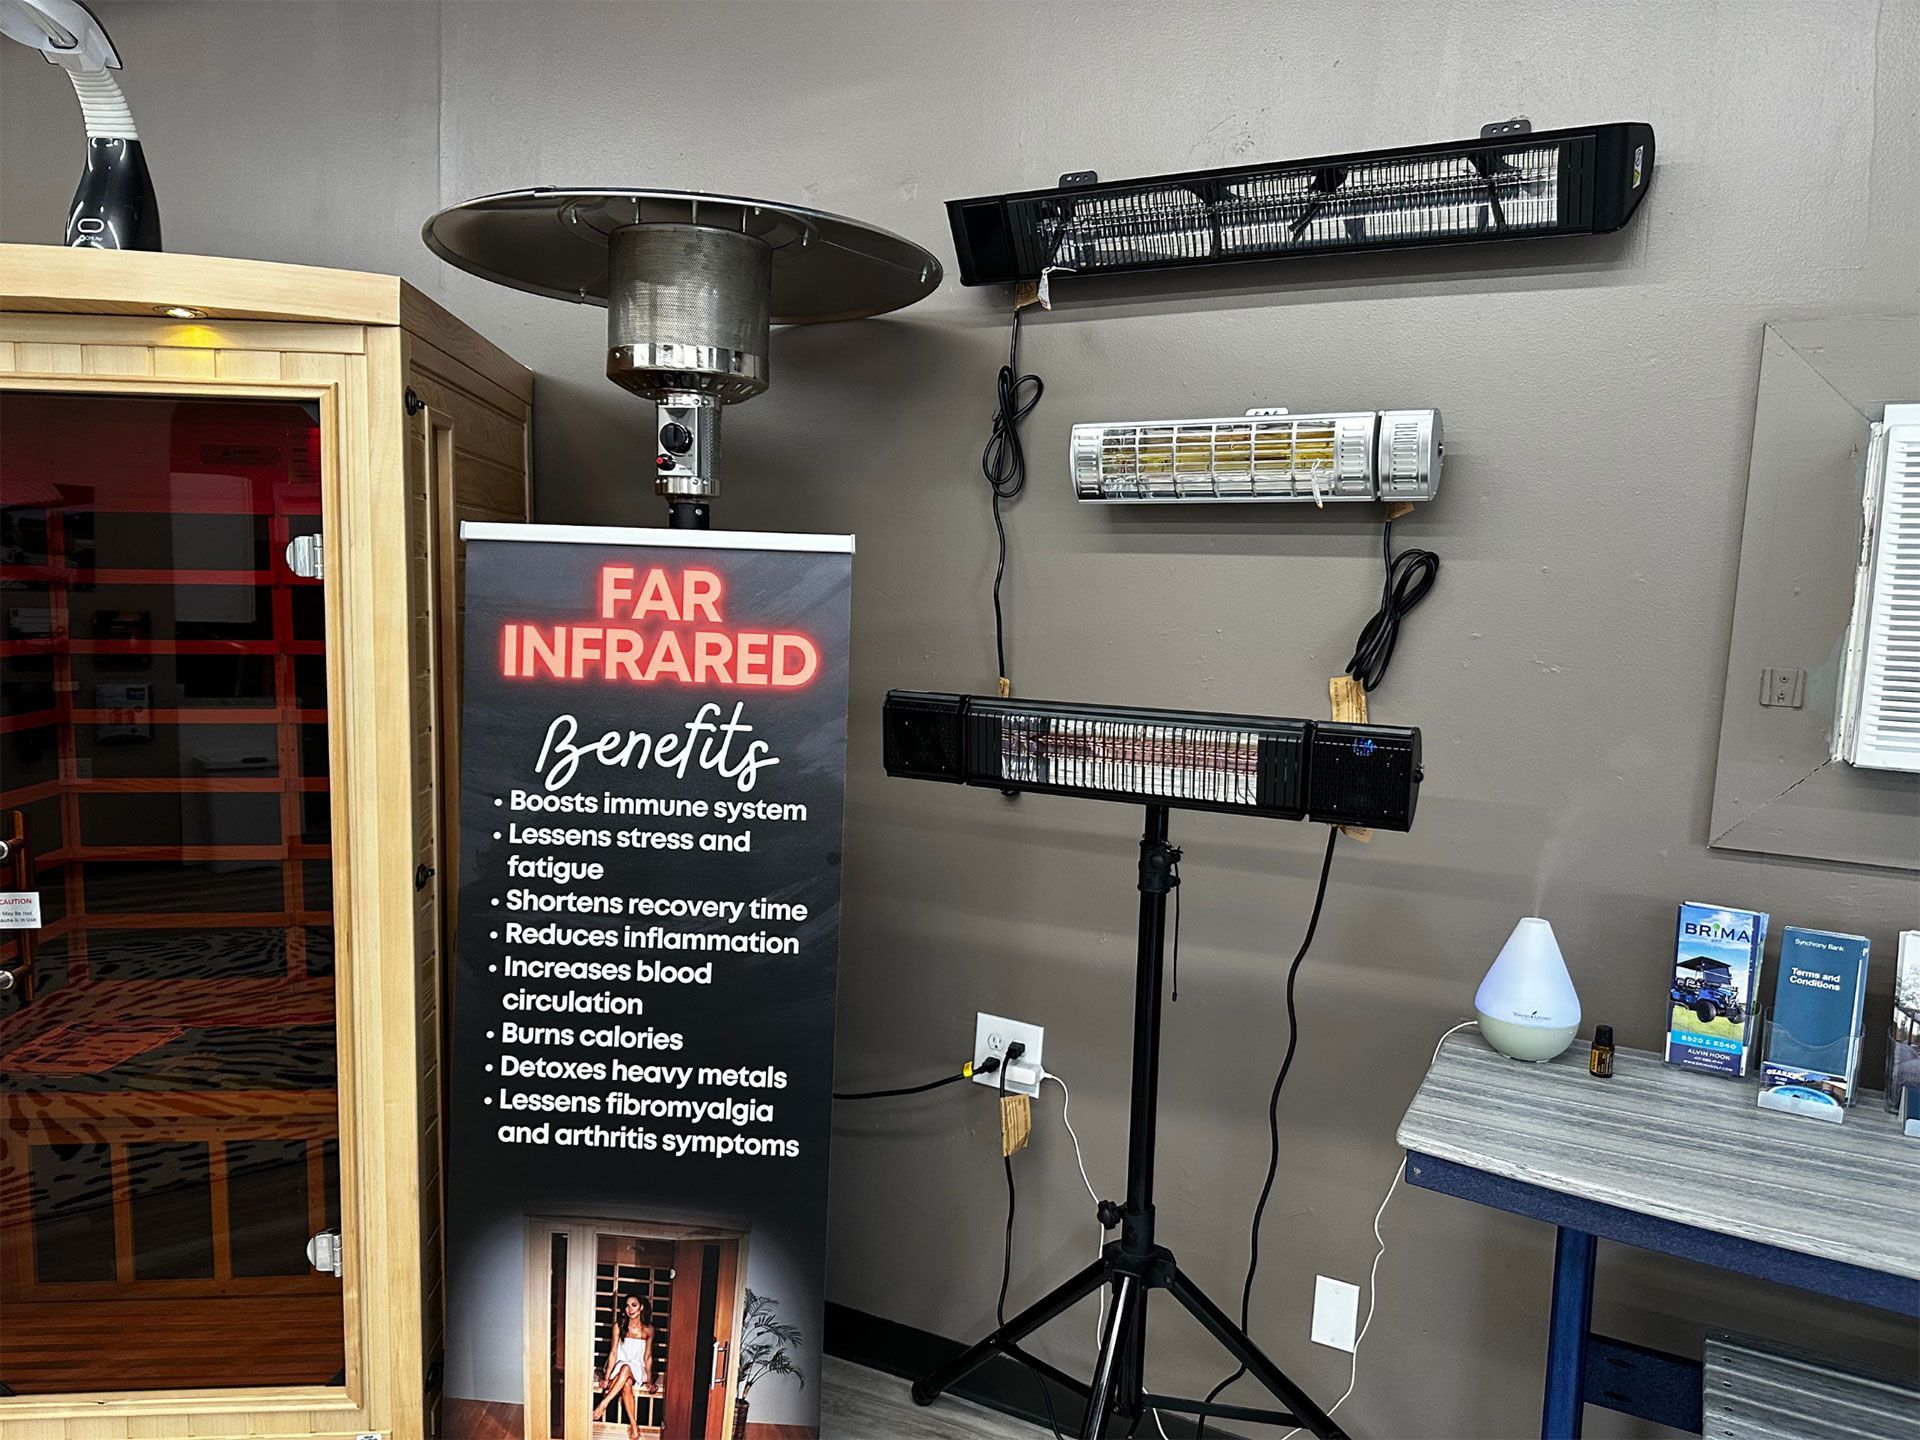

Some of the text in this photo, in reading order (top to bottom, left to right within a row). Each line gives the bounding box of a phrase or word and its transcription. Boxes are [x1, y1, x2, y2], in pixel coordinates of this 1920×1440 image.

[602, 566, 722, 622] FAR
[503, 624, 818, 686] INFRARED
[535, 702, 779, 792] Benefits
[511, 790, 806, 823] Boosts immune system
[510, 823, 750, 852] Lessens stress and
[507, 855, 604, 884] fatigue
[507, 889, 808, 923] Shortens recovery time
[506, 923, 799, 954] Reduces inflammation
[1794, 938, 1845, 952] Synchrony Bank
[505, 956, 712, 984] Increases blood
[1789, 975, 1841, 991] Conditions
[1791, 967, 1841, 983] Terms and
[503, 988, 642, 1015] circulation
[502, 1022, 683, 1050] Burns calories
[1687, 1048, 1709, 1057] ALVIN
[1709, 1052, 1731, 1061] HOOK
[501, 1055, 787, 1089] Detoxes heavy metals
[500, 1089, 773, 1126] Lessens fibromyalgia
[498, 1123, 799, 1158] and arthritis symptoms
